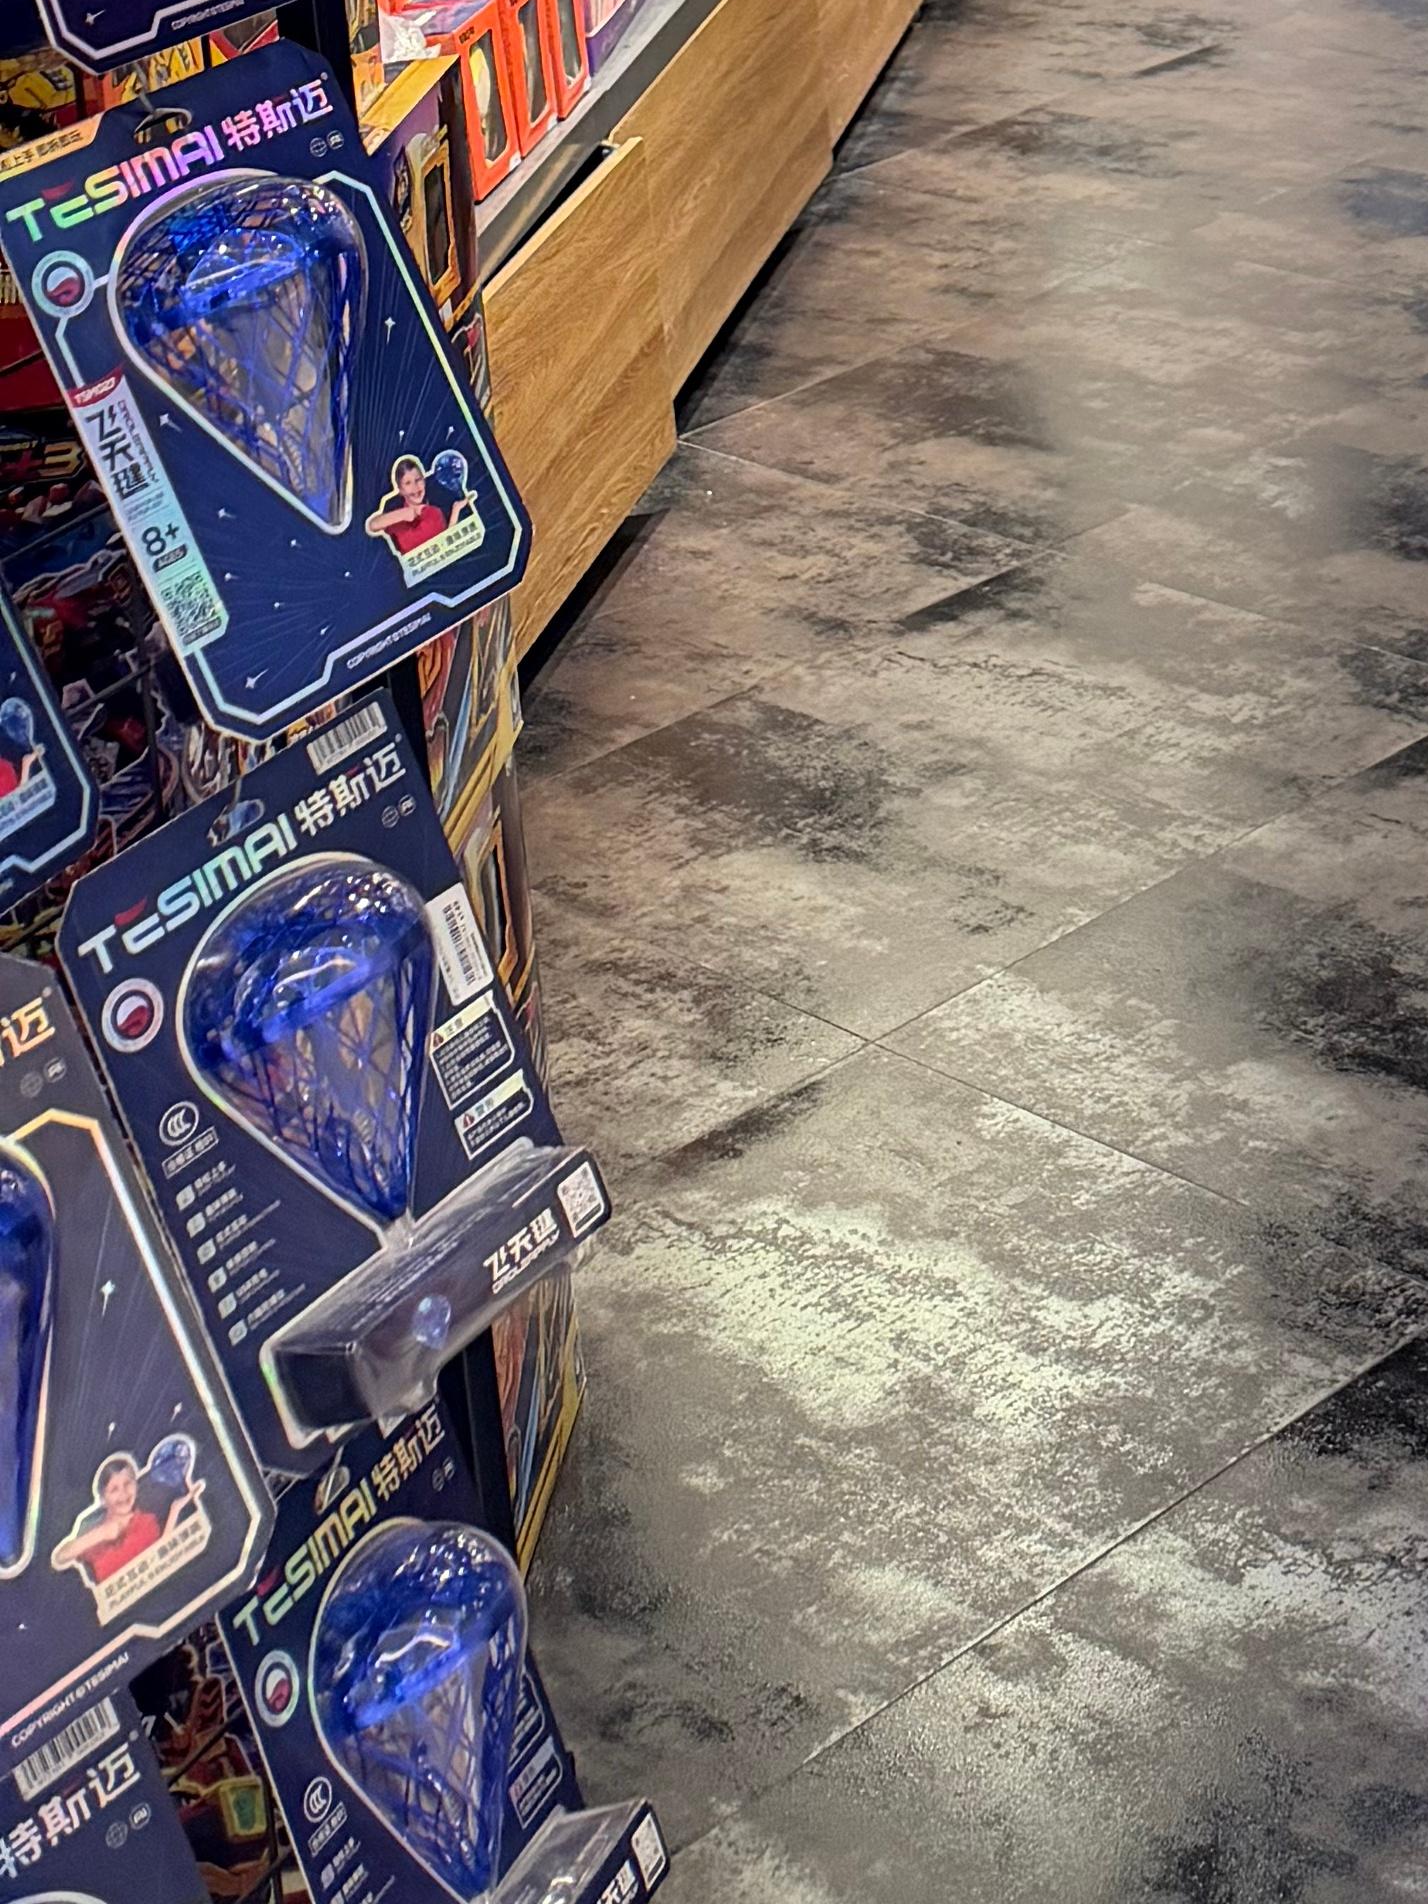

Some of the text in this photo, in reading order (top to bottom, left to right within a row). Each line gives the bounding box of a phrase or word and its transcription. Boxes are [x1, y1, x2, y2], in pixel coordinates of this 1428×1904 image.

[6, 78, 335, 242] TESIMAI 特斯迈
[142, 522, 181, 557] 8+
[77, 812, 299, 975] TESIMAI
[293, 741, 407, 838] 特斯迈
[232, 1403, 446, 1647] TESIMAI 特斯迈
[0, 1742, 142, 1879] 特斯迈
